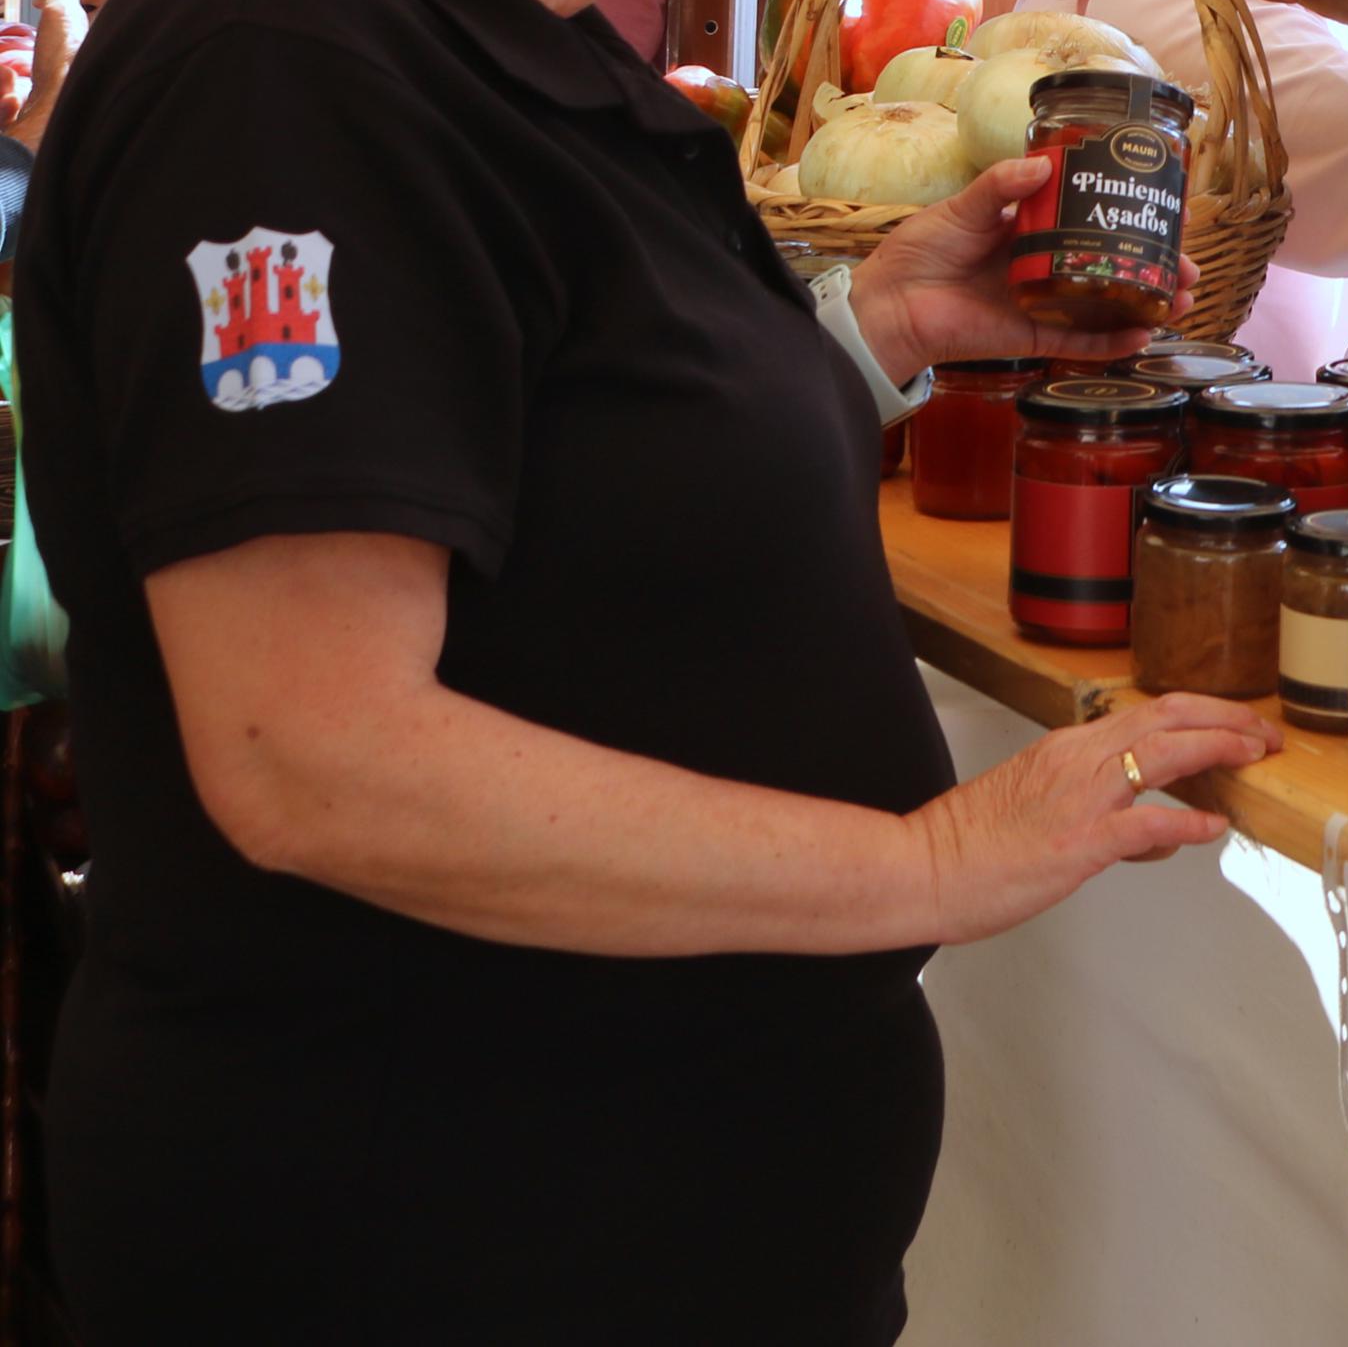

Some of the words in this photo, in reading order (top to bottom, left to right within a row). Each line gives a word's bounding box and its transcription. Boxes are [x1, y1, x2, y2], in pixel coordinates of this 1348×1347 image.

[1122, 142, 1158, 158] MAURI
[1072, 170, 1181, 214] Pimientos
[1086, 202, 1168, 236] Asados
